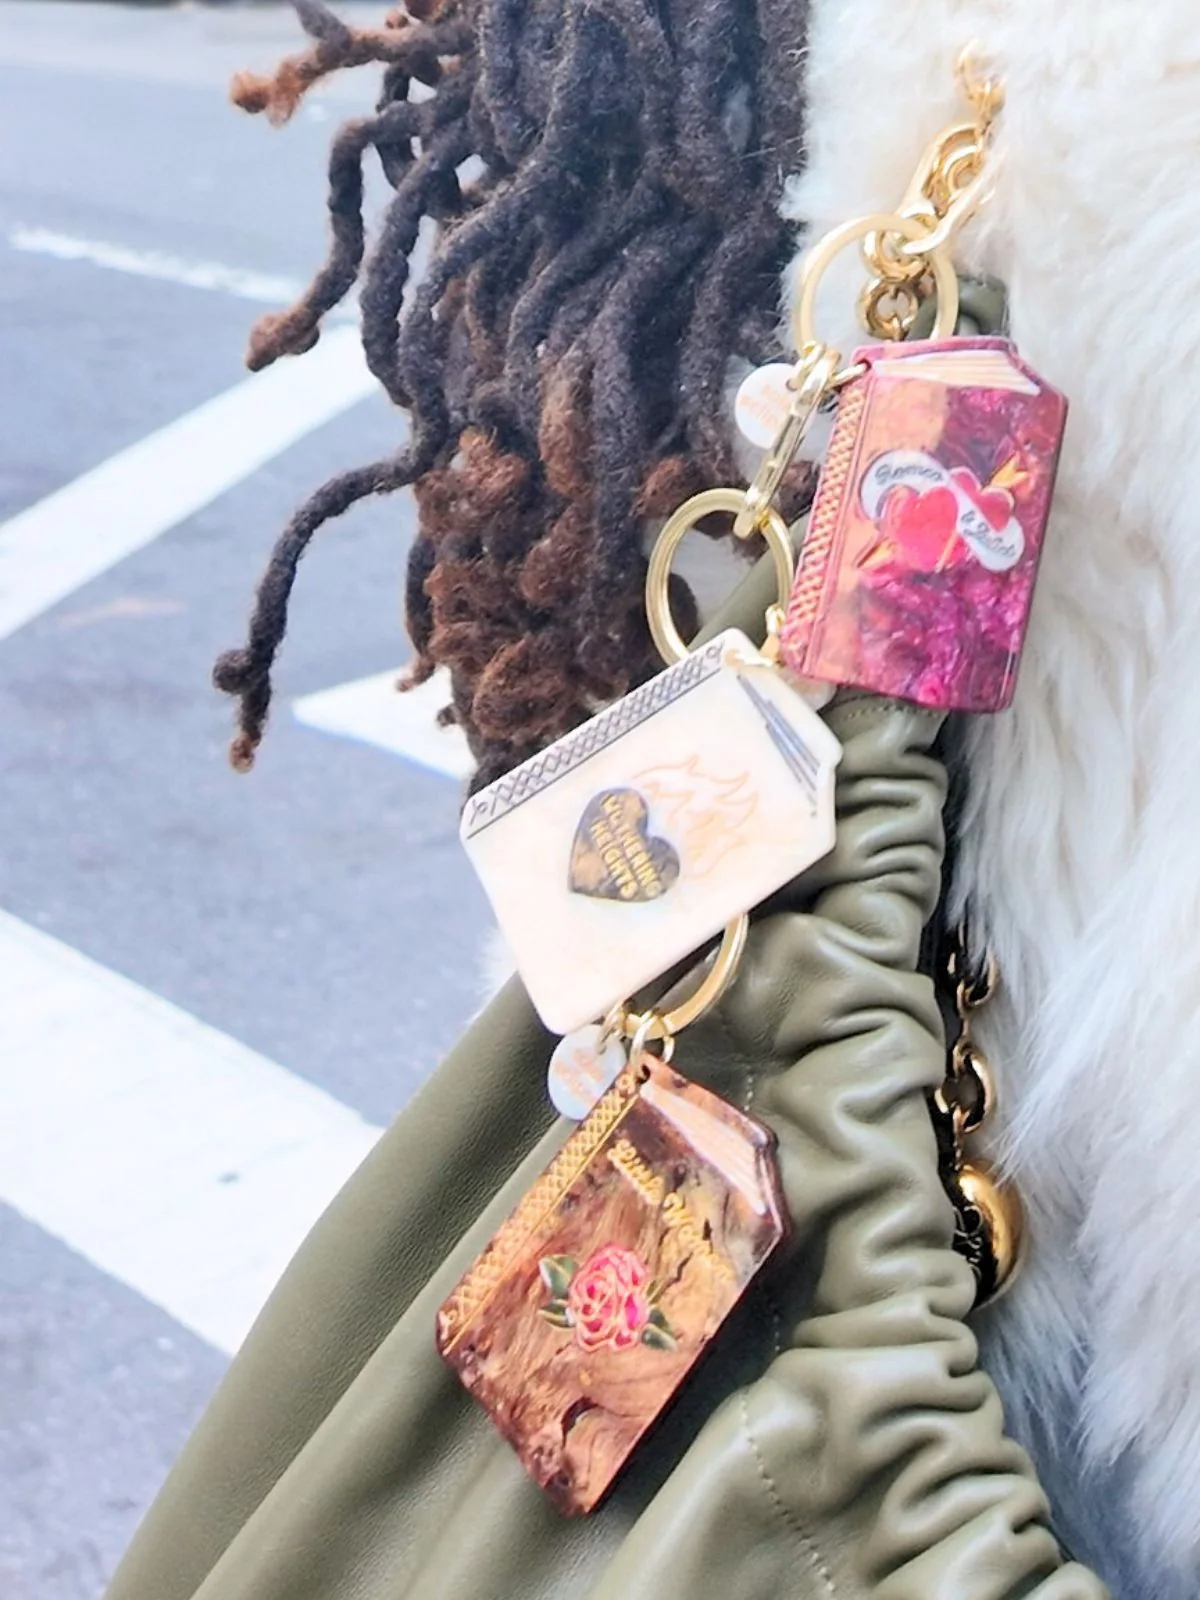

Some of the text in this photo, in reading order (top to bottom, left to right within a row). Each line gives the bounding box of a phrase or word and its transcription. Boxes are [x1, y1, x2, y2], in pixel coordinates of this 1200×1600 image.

[590, 818, 638, 898] HEIGHTS
[600, 793, 661, 897] WUTHERING
[606, 1138, 662, 1206] Little
